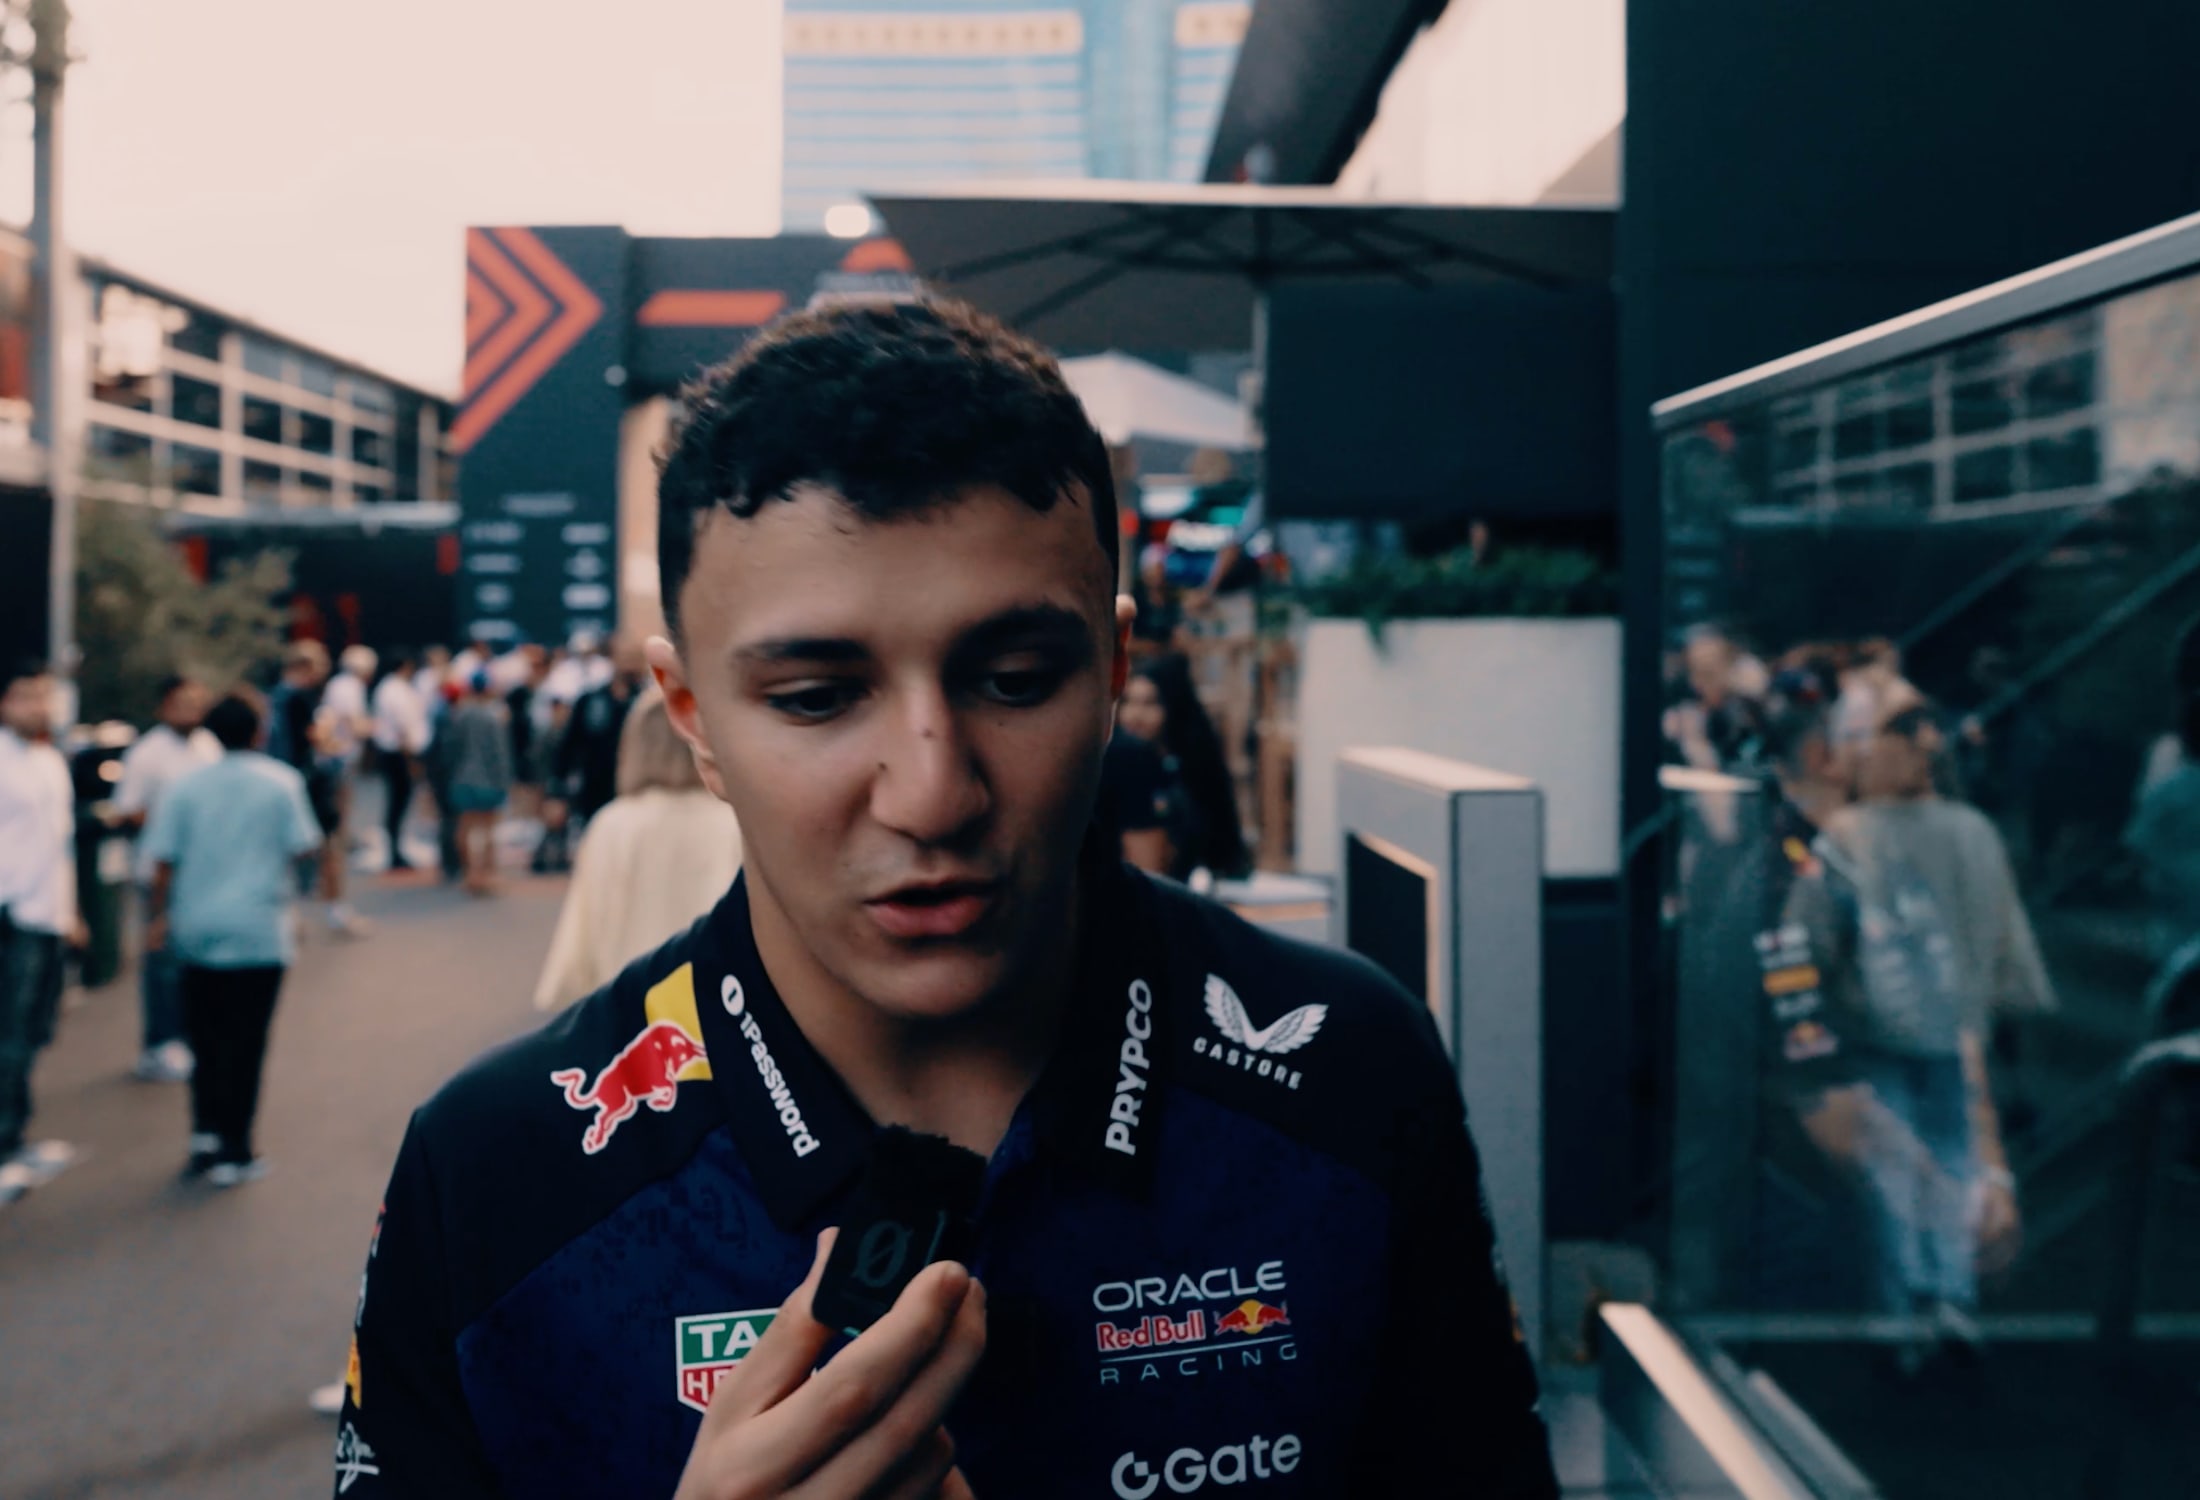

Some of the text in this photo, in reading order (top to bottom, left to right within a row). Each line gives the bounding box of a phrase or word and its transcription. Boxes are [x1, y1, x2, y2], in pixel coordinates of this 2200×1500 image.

[740, 1011, 820, 1157] 1Password
[1105, 978, 1152, 1156] PRYPCO
[1193, 1037, 1303, 1090] CASTORE
[1093, 1260, 1287, 1312] ORACLE
[688, 1320, 759, 1358] TA
[1096, 1309, 1206, 1352] Red Bull
[1100, 1343, 1297, 1385] RACING
